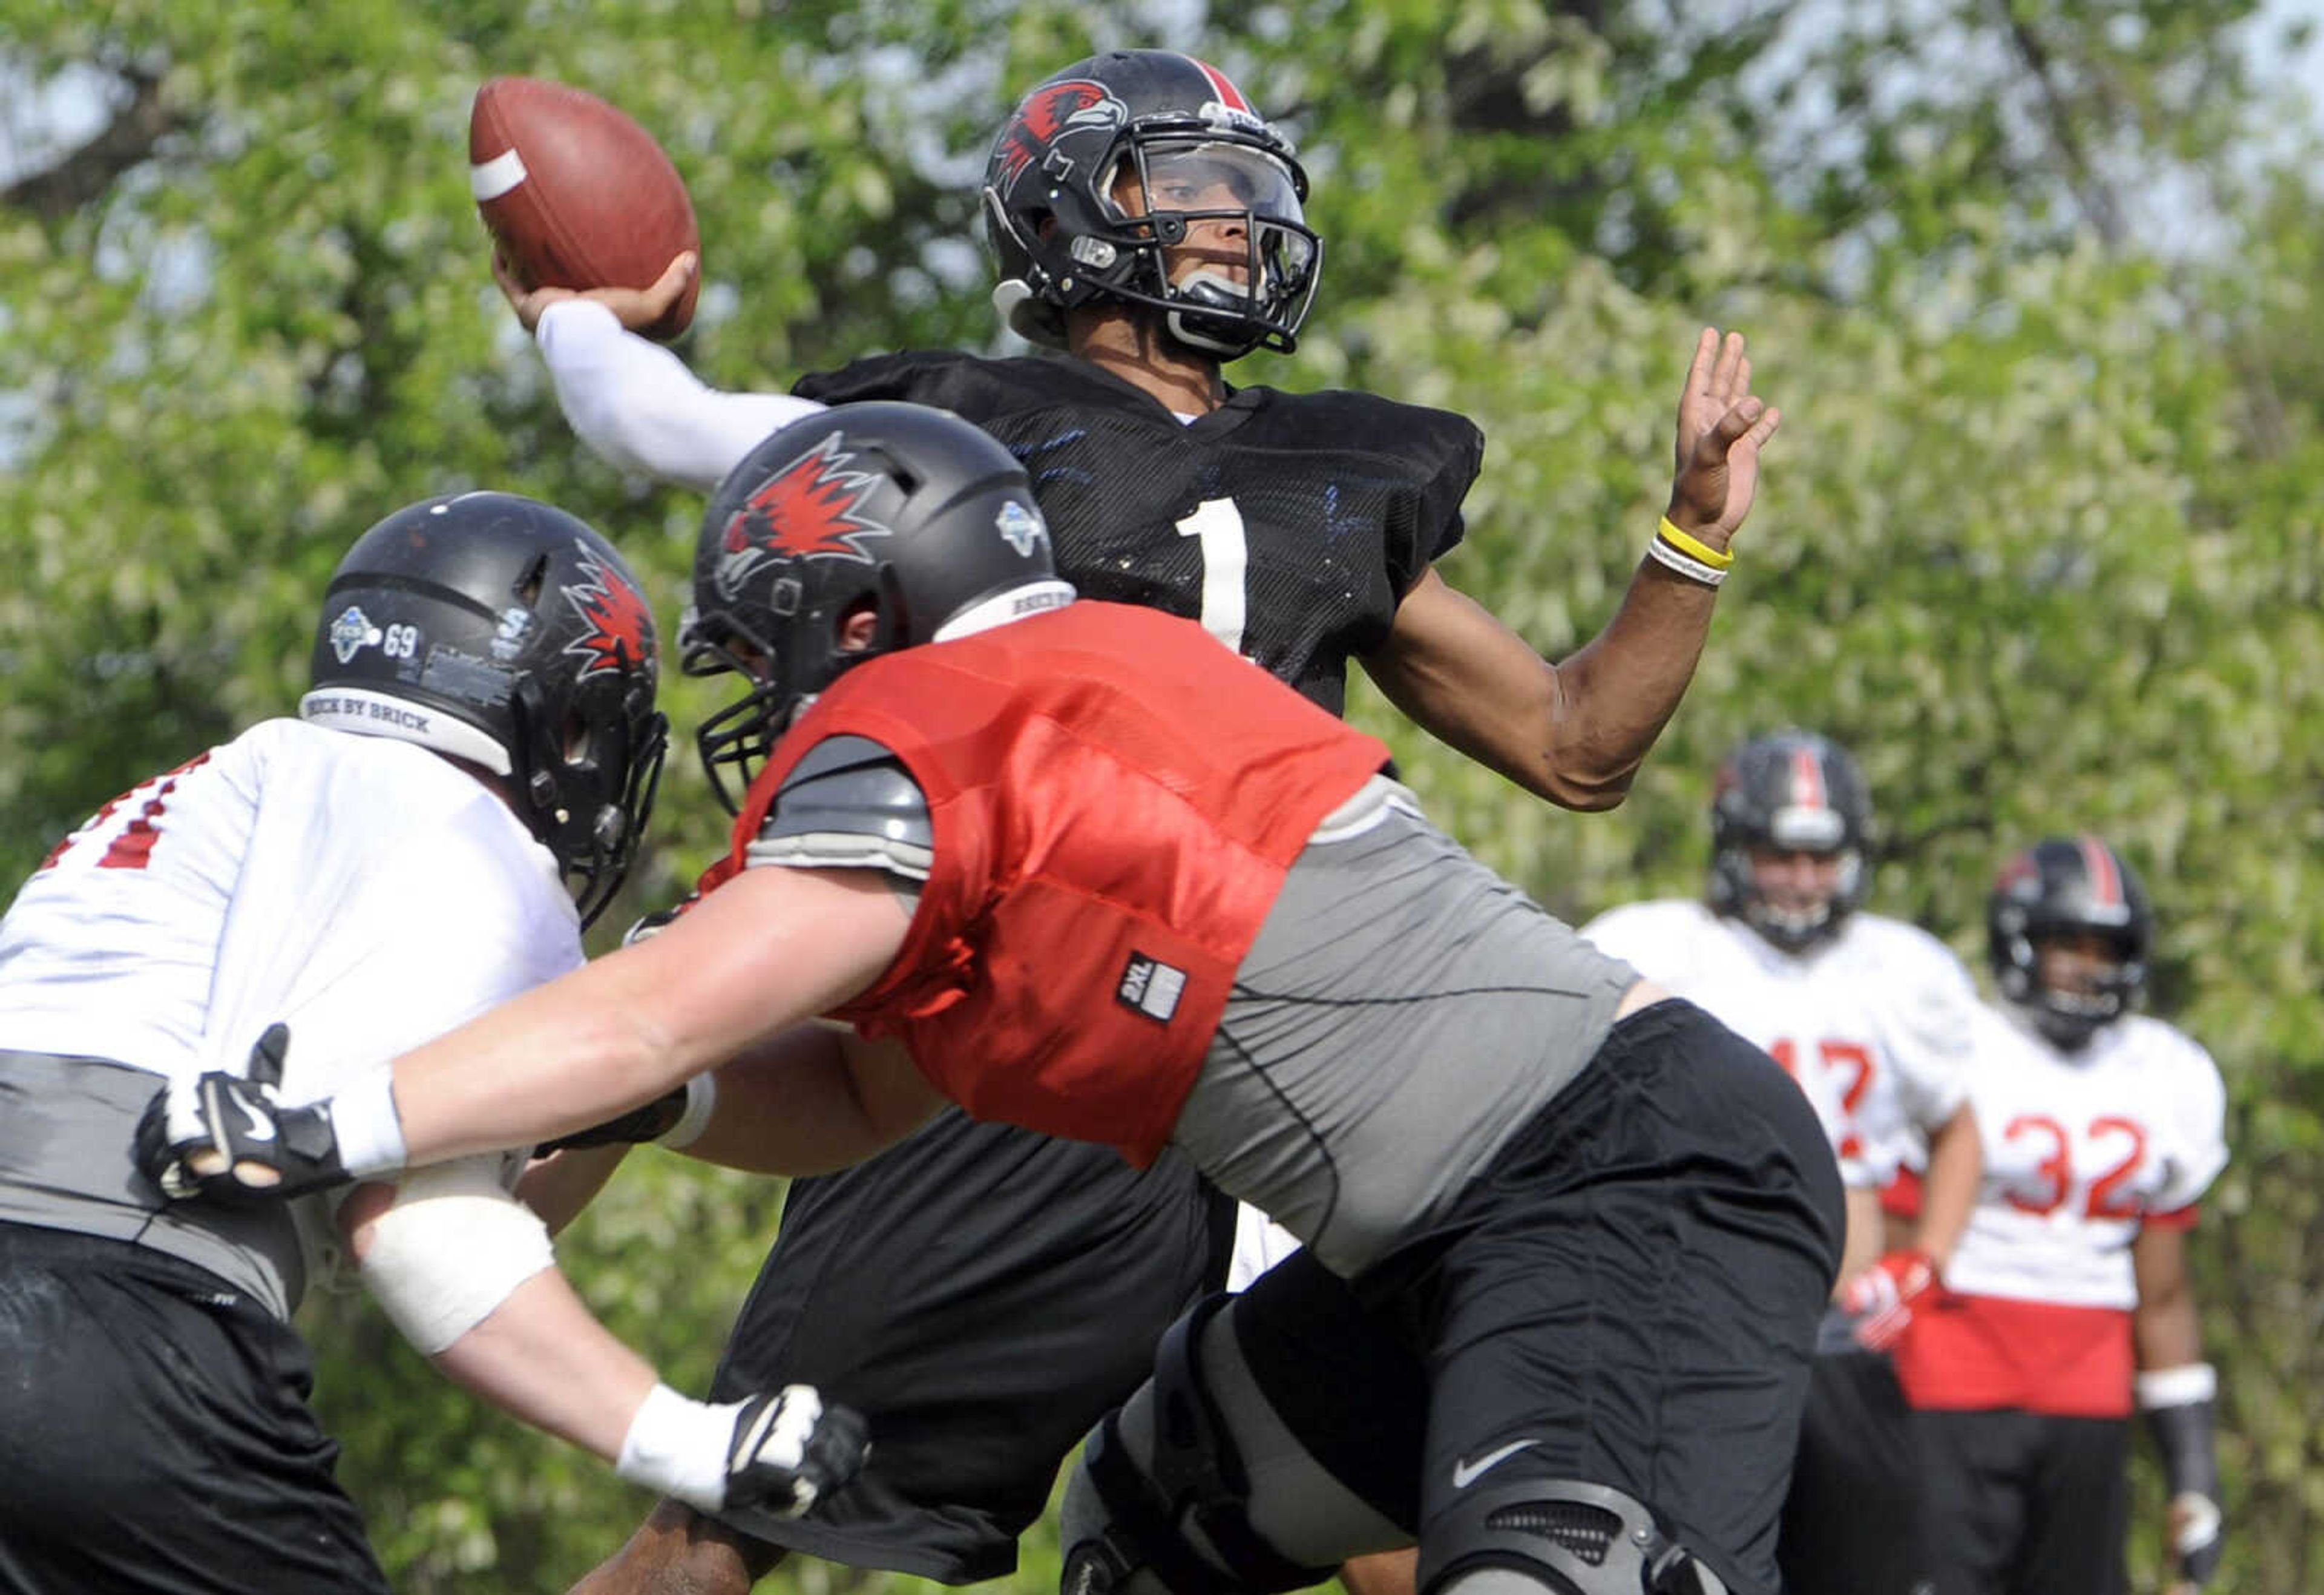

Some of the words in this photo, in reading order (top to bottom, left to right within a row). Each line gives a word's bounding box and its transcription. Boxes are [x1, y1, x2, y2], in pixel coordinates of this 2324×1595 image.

[1175, 497, 1255, 665] 1
[384, 624, 417, 658] 69
[344, 699, 366, 715] BY
[370, 703, 430, 733] BRICK
[2000, 1114, 2144, 1218] 32
